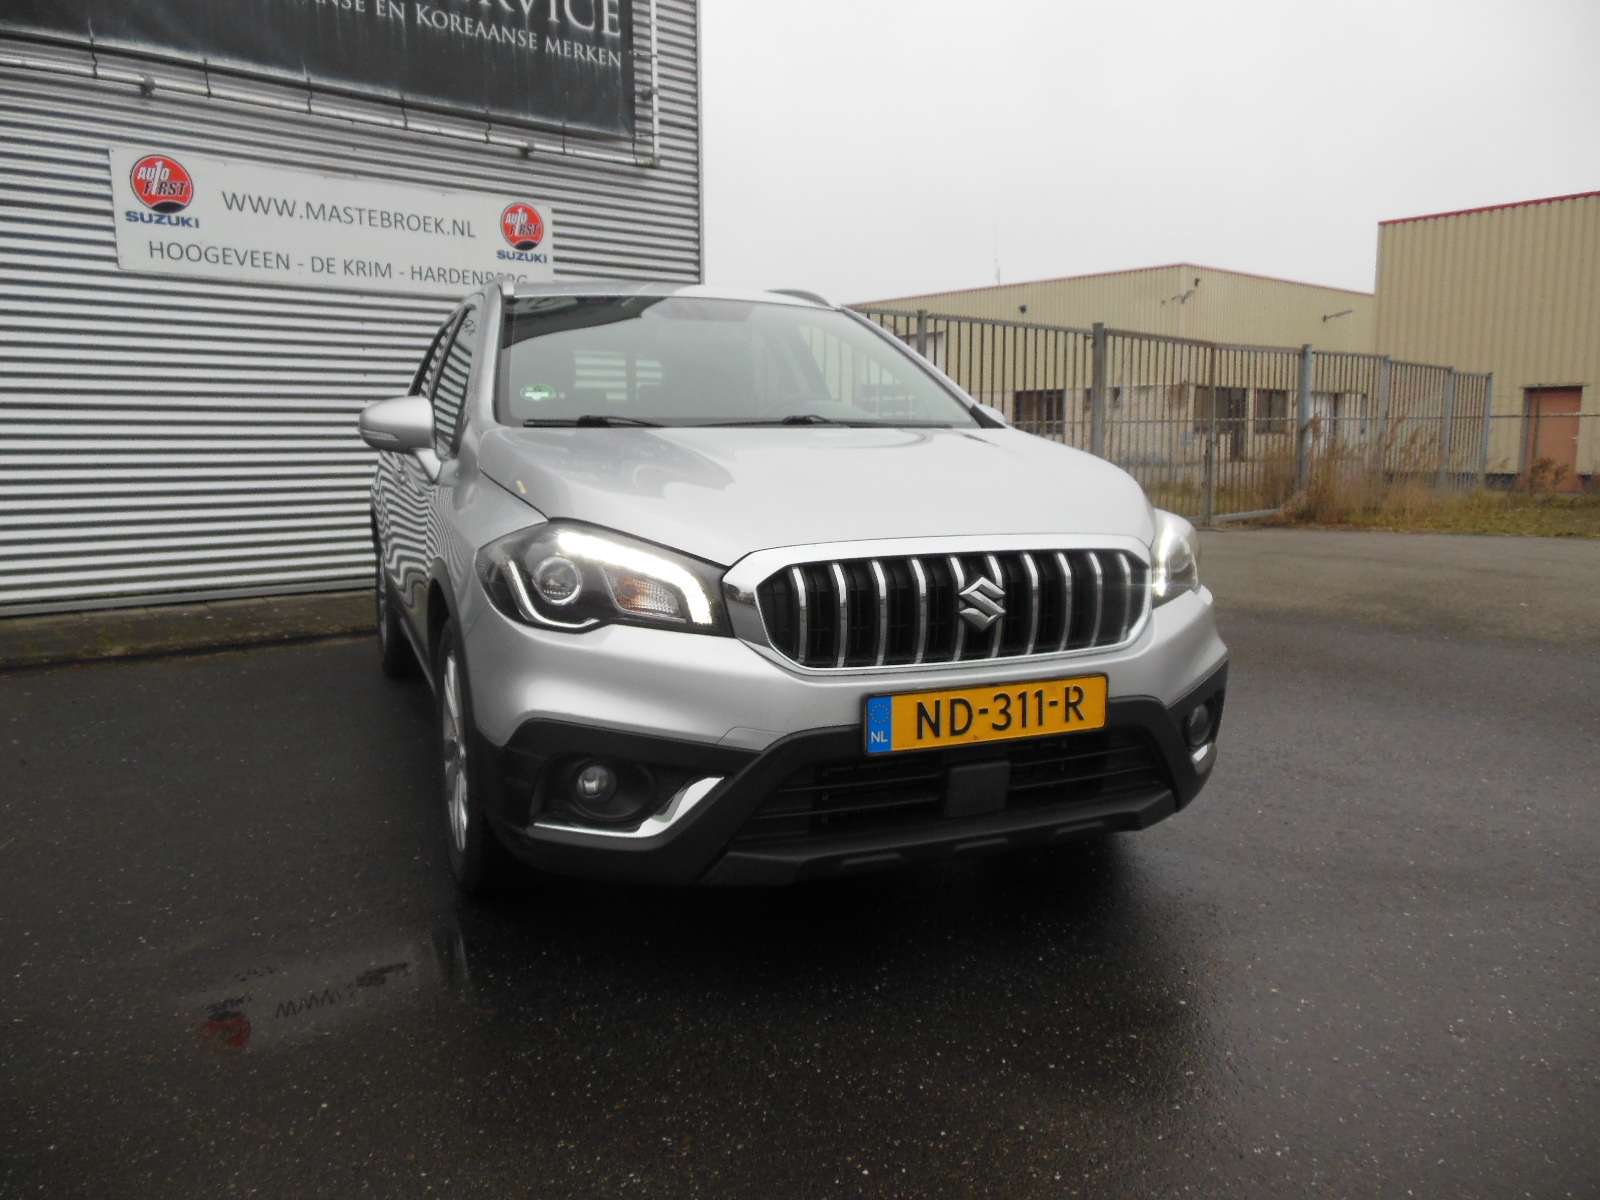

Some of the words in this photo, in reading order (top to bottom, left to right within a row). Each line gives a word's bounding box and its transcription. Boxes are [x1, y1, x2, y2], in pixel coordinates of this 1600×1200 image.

[376, 0, 405, 20] EN
[416, 4, 537, 50] KOREAANSE
[545, 37, 621, 67] MERKEN
[126, 211, 199, 229] SUZUKI
[222, 191, 476, 238] WWW.MASTEBROEK.NL
[148, 241, 290, 270] HOOGEVEEN
[311, 256, 336, 274] DE
[344, 258, 392, 279] KRIM
[496, 249, 547, 264] SUZUKI
[916, 685, 1085, 740] ND-311-R
[870, 731, 889, 744] NL
